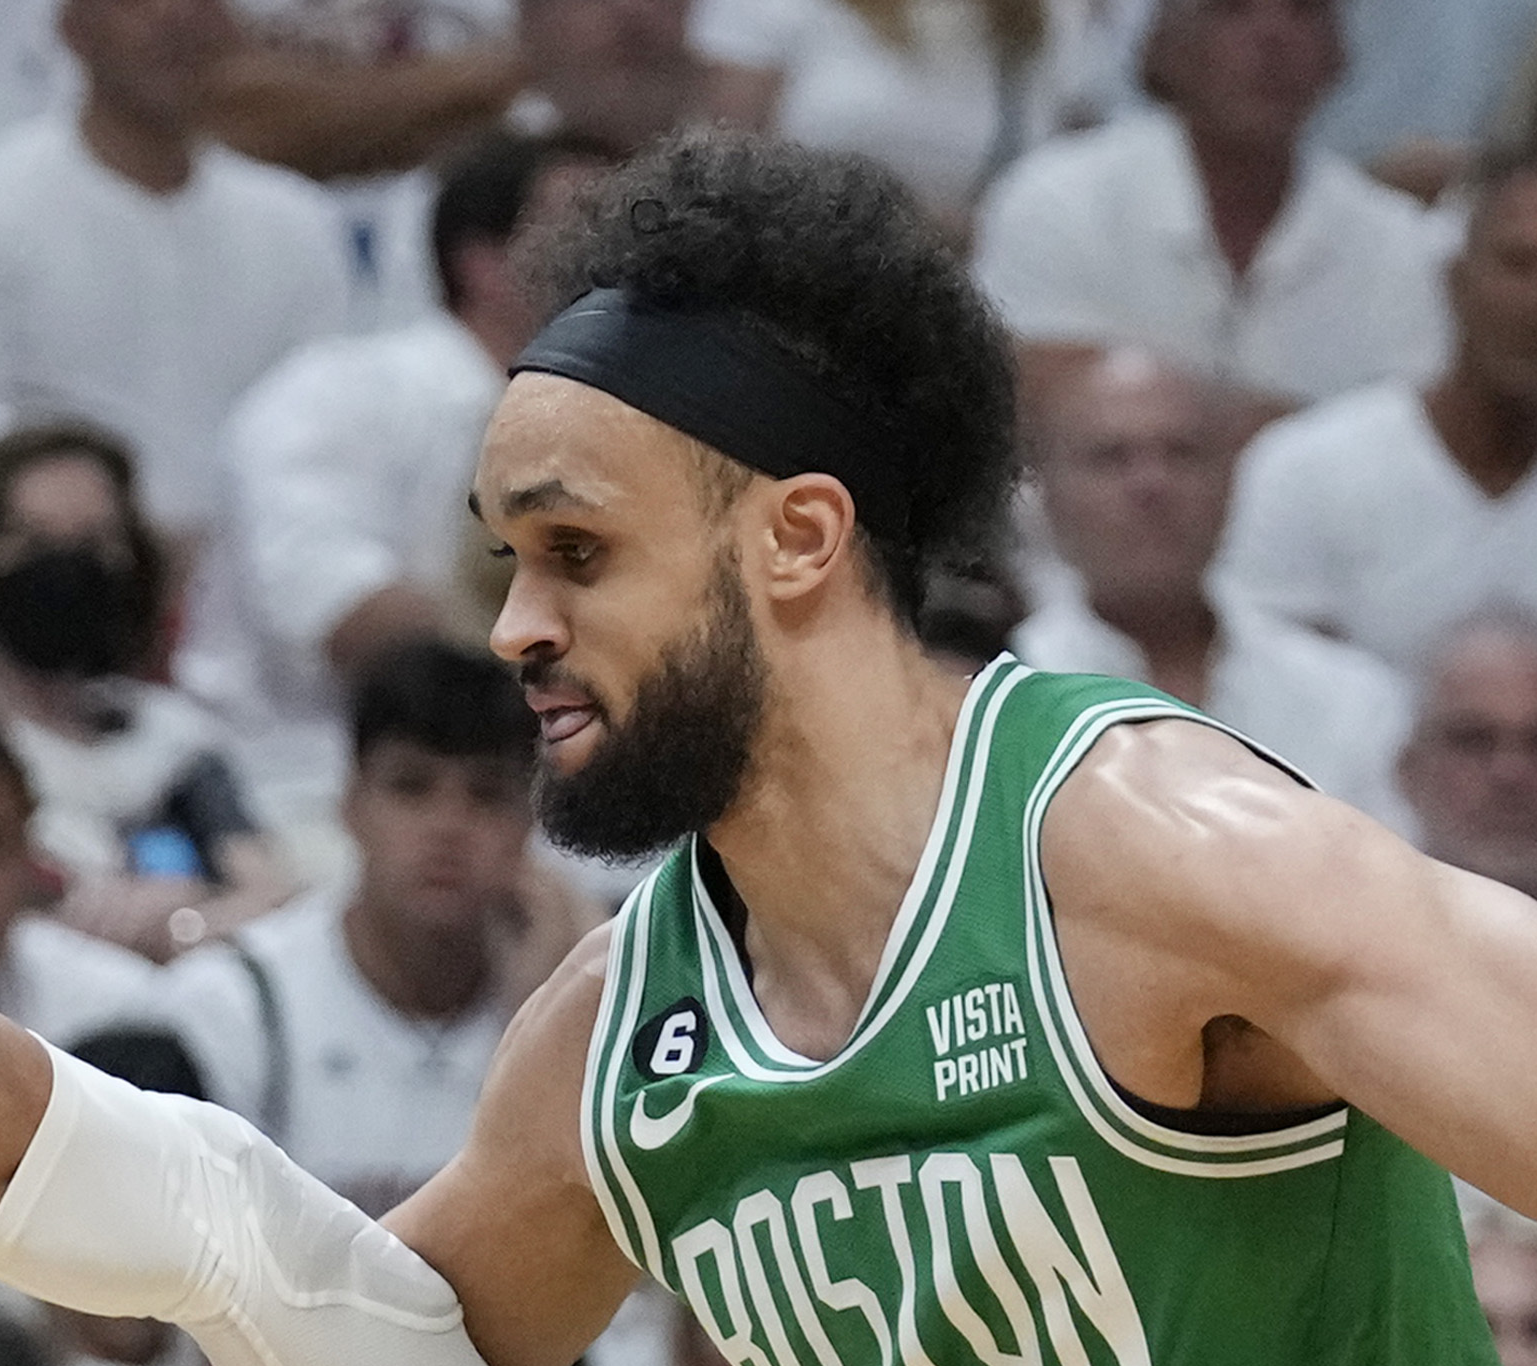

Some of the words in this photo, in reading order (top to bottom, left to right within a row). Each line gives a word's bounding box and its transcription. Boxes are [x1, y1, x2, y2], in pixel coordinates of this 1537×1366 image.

[648, 1009, 697, 1075] 6
[926, 982, 1025, 1056] VISTA
[933, 1038, 1029, 1102] PRINT
